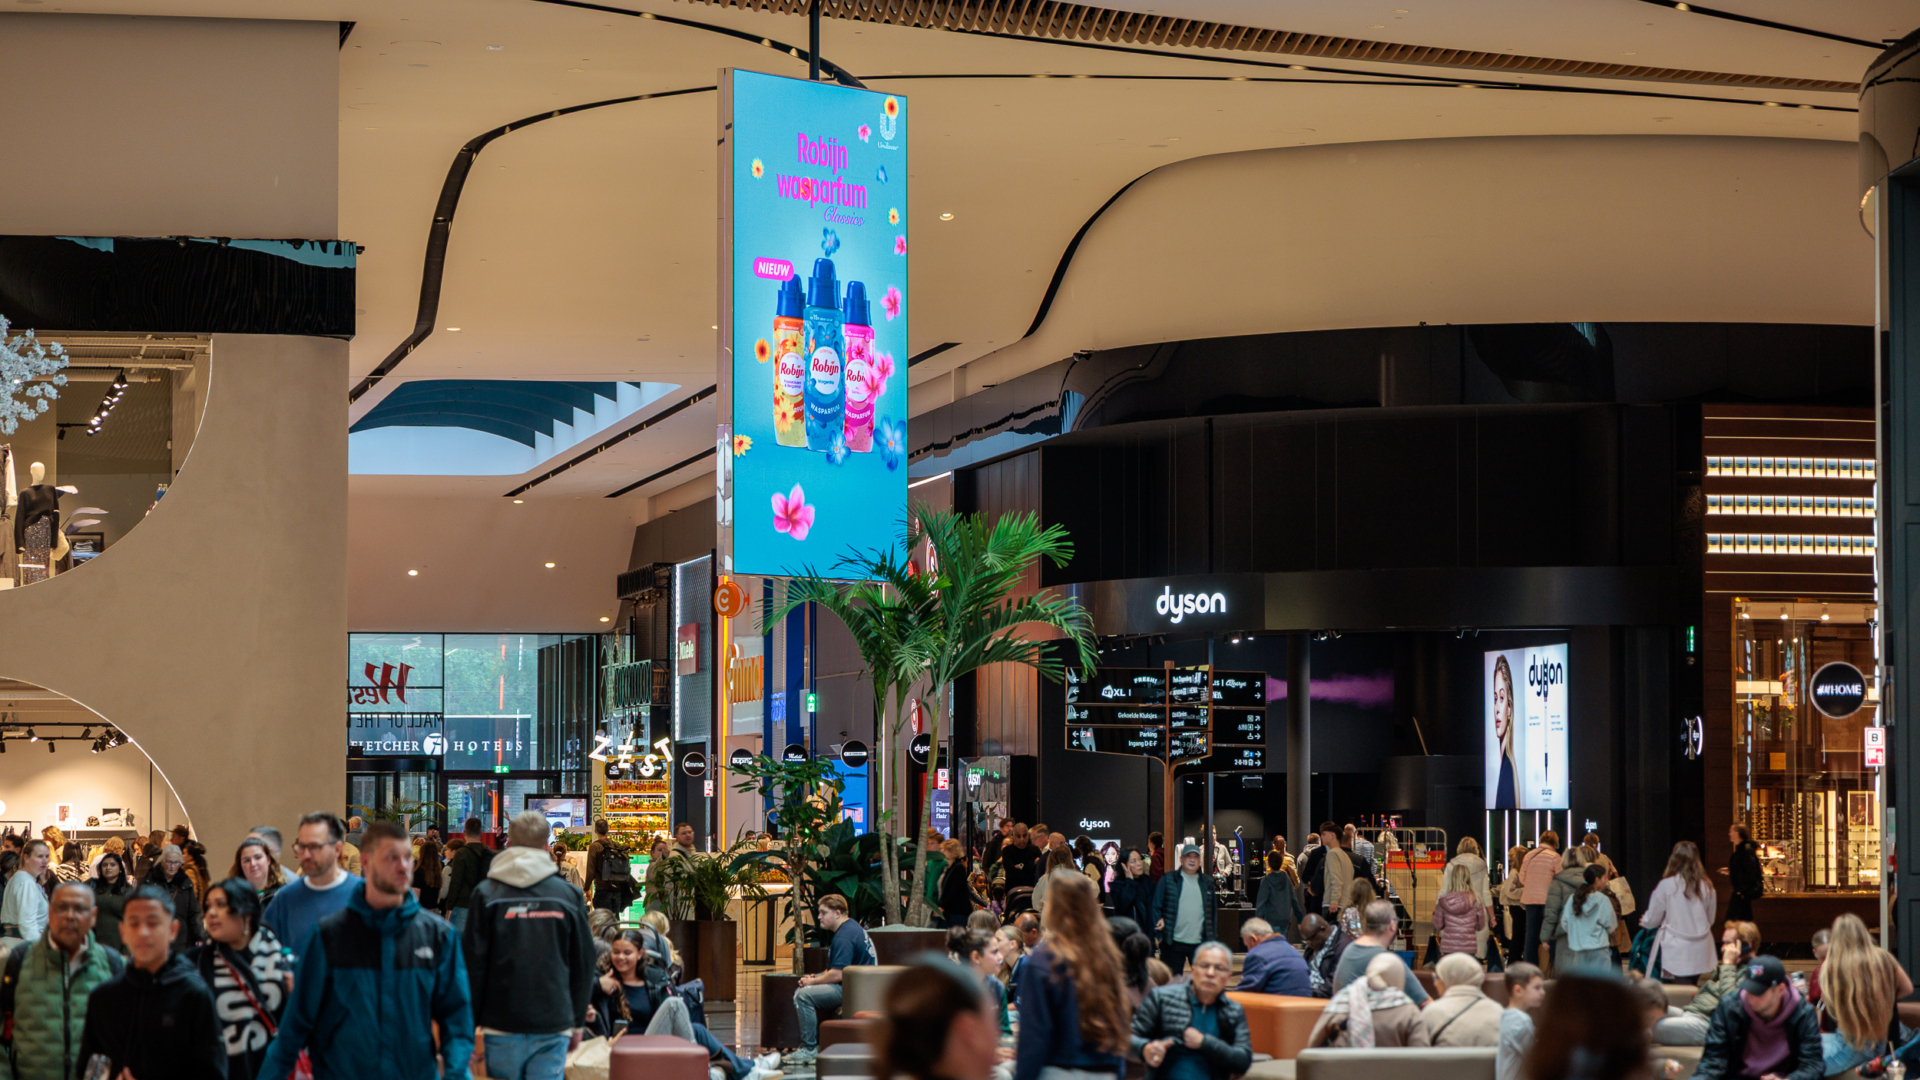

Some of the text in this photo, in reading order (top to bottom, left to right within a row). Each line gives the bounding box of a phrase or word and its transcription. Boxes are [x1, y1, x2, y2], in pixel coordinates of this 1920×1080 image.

[798, 133, 848, 175] Robijn
[777, 173, 867, 209] wasparfum
[824, 206, 865, 226] Classics
[758, 261, 790, 277] NIEUW
[812, 358, 839, 376] Robijn
[811, 402, 840, 415] WASPARFUM
[1156, 585, 1227, 624] dyson
[1114, 688, 1126, 697] XL
[1139, 731, 1157, 739] Parking
[1871, 733, 1878, 742] B
[453, 740, 523, 752] HOTELS
[1128, 740, 1144, 748] Ingang
[589, 731, 673, 777] ZEST
[592, 785, 602, 823] ORDER
[1080, 818, 1110, 830] dyson
